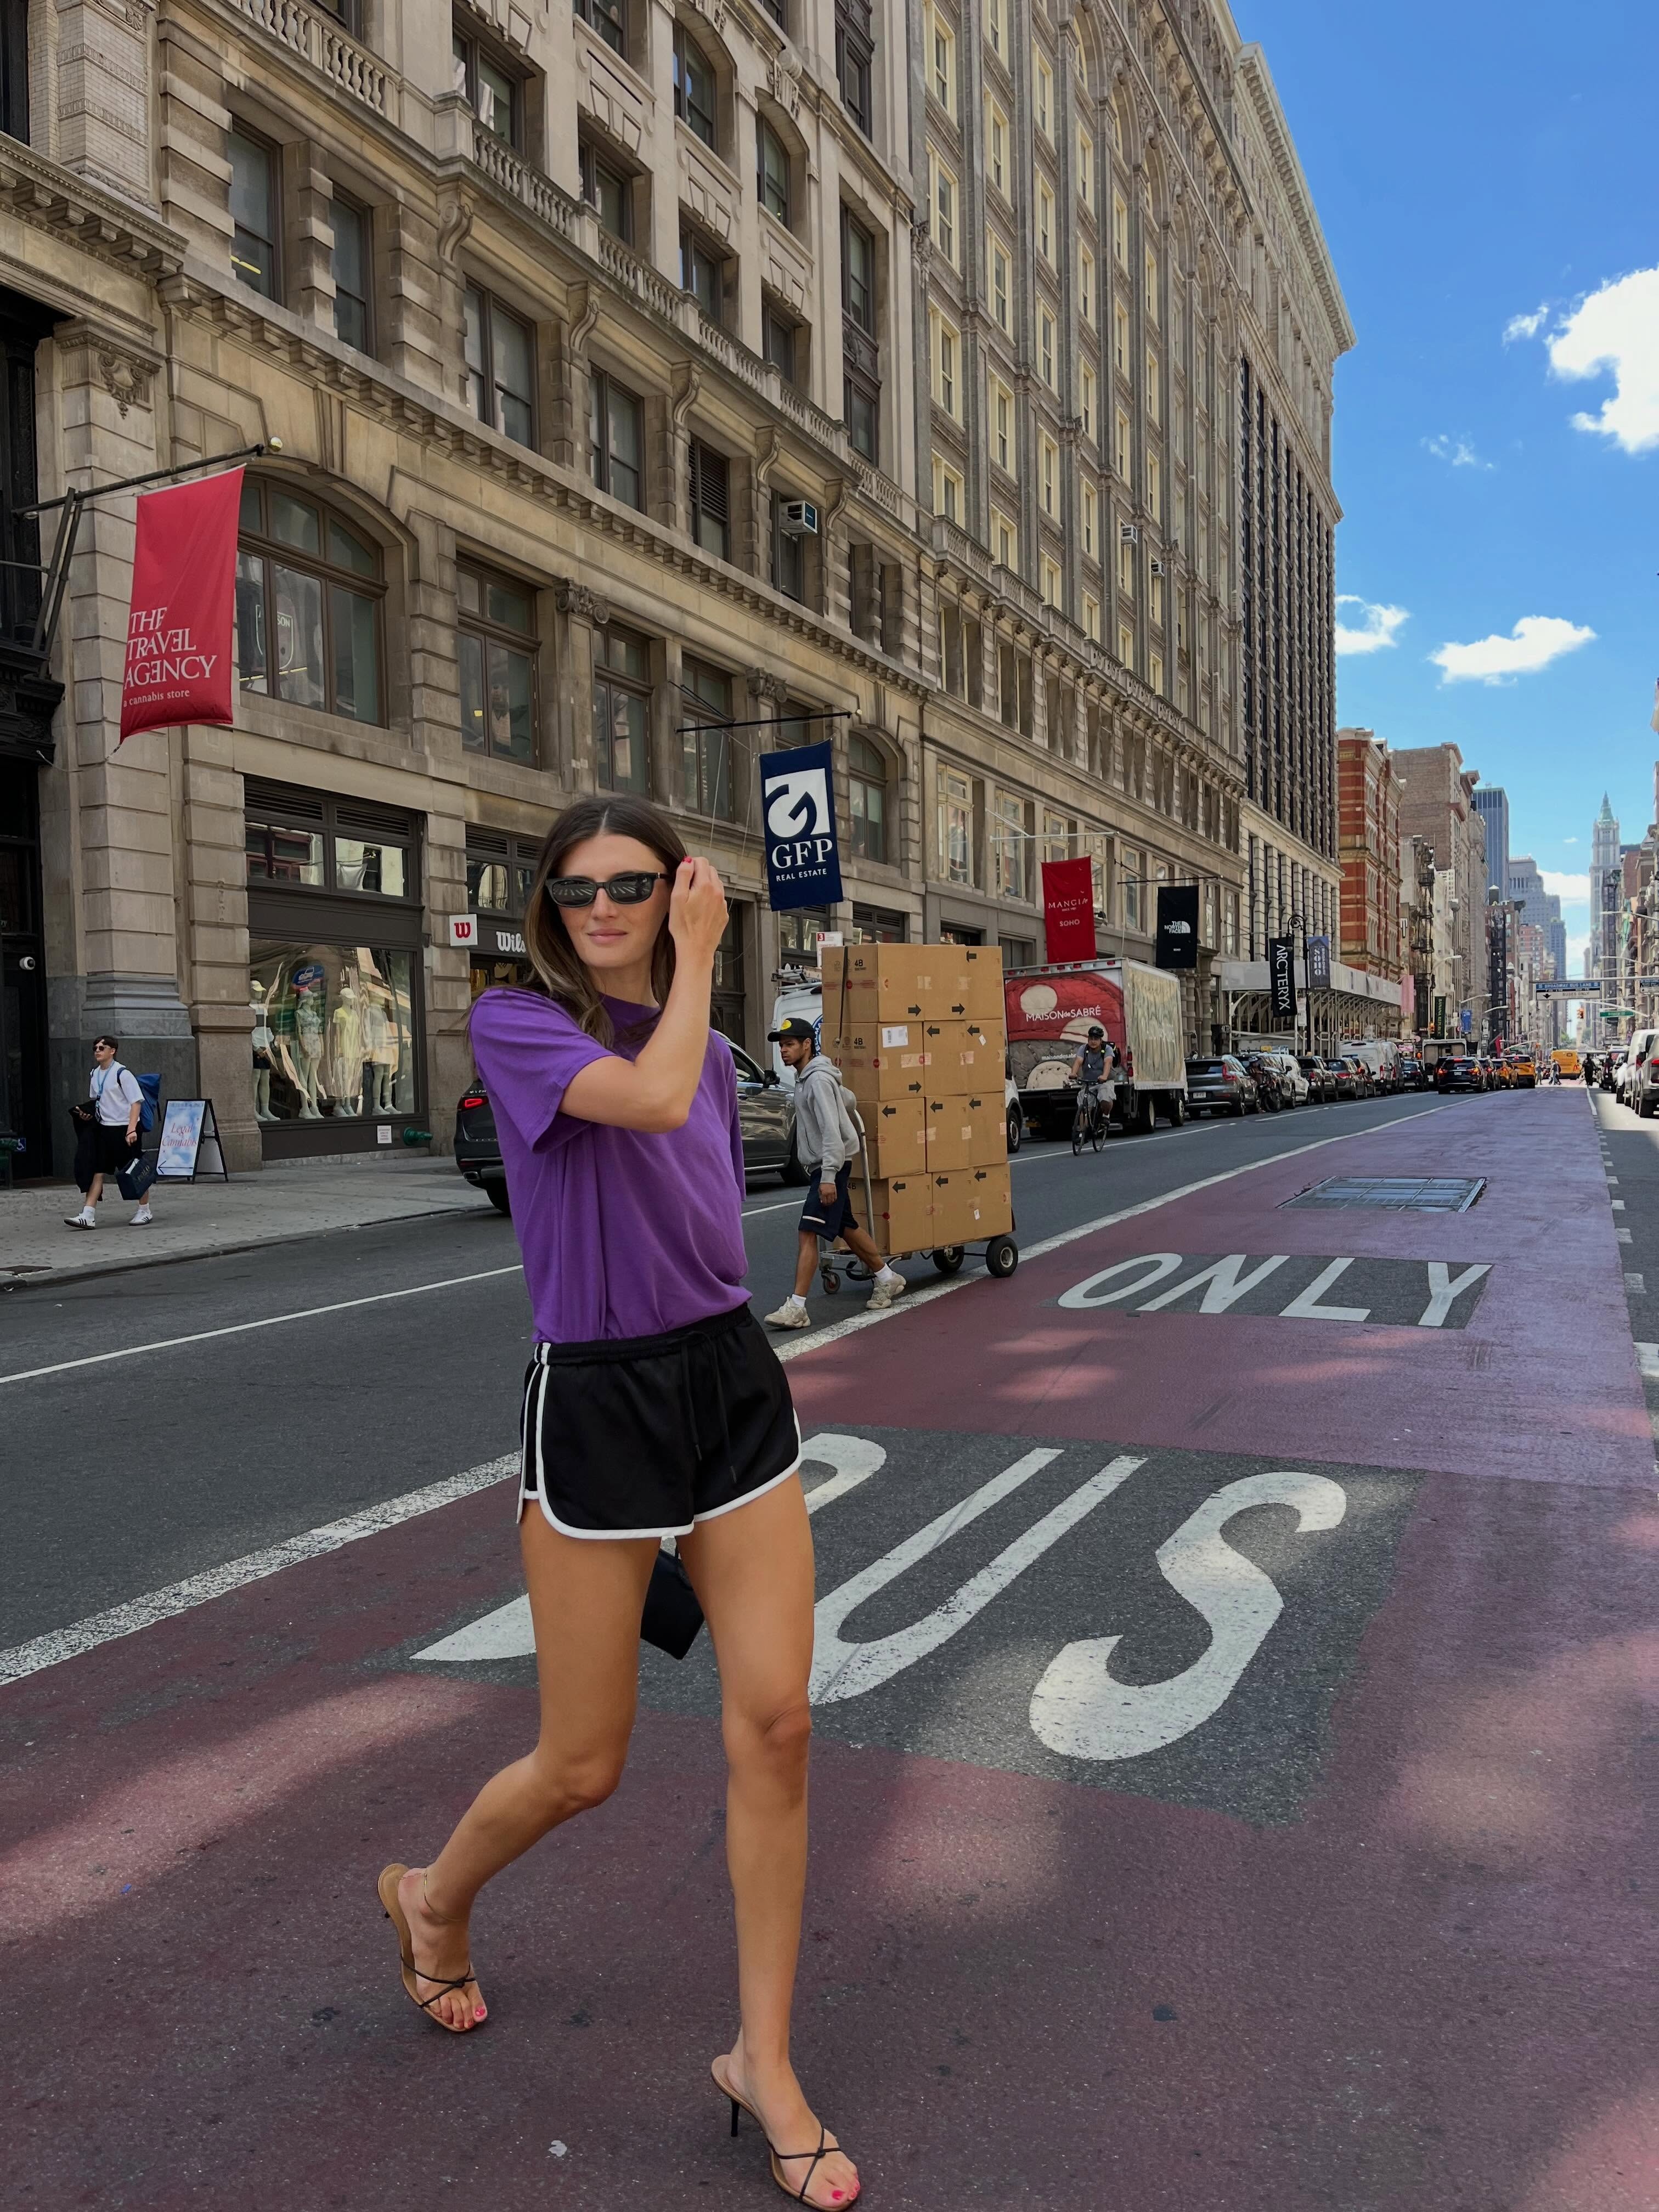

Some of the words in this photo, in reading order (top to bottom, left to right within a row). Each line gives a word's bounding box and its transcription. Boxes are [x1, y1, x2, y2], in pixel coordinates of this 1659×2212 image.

[131, 606, 167, 634] THE
[127, 628, 196, 661] TRAVEL
[123, 655, 217, 690] AGENCY
[129, 691, 164, 706] cannabis
[167, 690, 190, 699] store
[771, 838, 833, 868] GFP
[799, 868, 827, 878] ESTATE
[496, 931, 527, 953] Wils
[162, 1136, 197, 1147] Cannabis
[171, 1122, 193, 1137] Legal
[1057, 1252, 1492, 1327] ONLY
